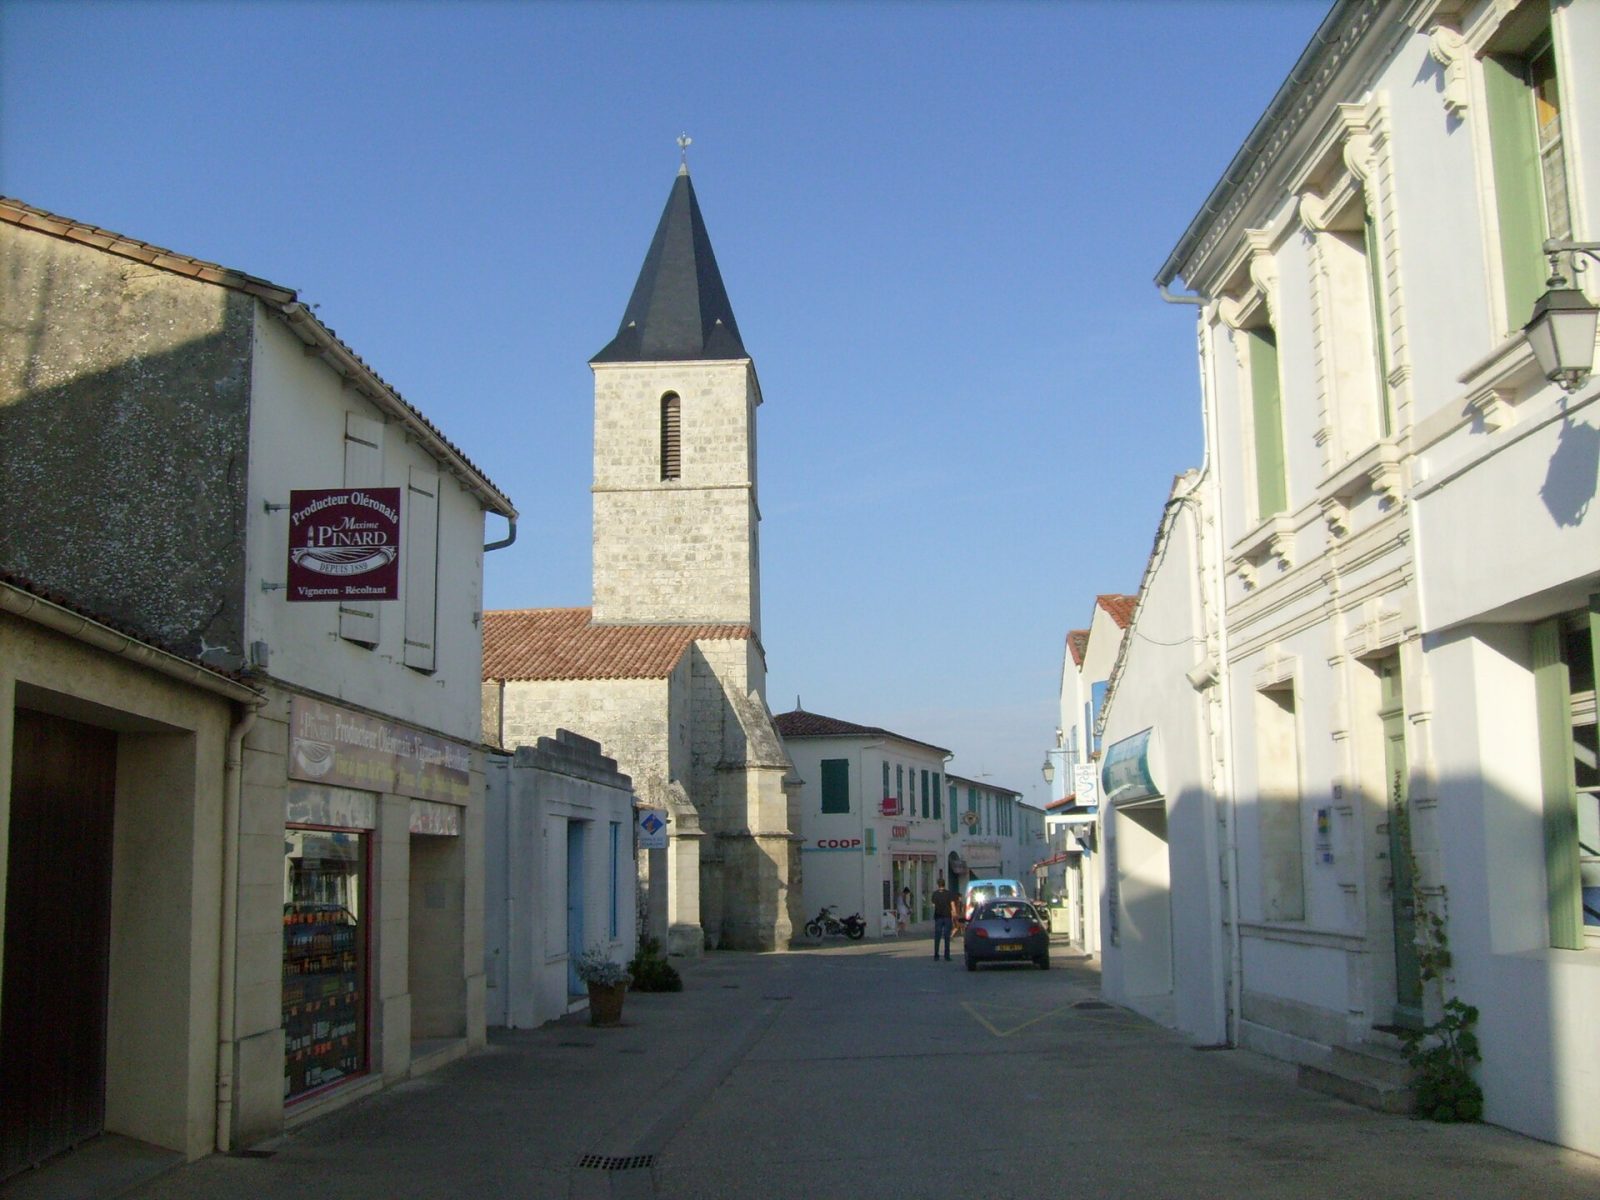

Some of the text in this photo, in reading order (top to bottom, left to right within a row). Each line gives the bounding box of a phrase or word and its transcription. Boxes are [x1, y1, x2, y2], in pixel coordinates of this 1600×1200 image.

[291, 491, 399, 526] Producteur Oléronais
[332, 516, 380, 531] Maxime
[317, 525, 388, 546] PINARD
[319, 562, 348, 573] DEPUIS
[297, 586, 339, 598] Vigneron
[345, 585, 387, 595] Récoltant
[817, 838, 861, 849] COOP
